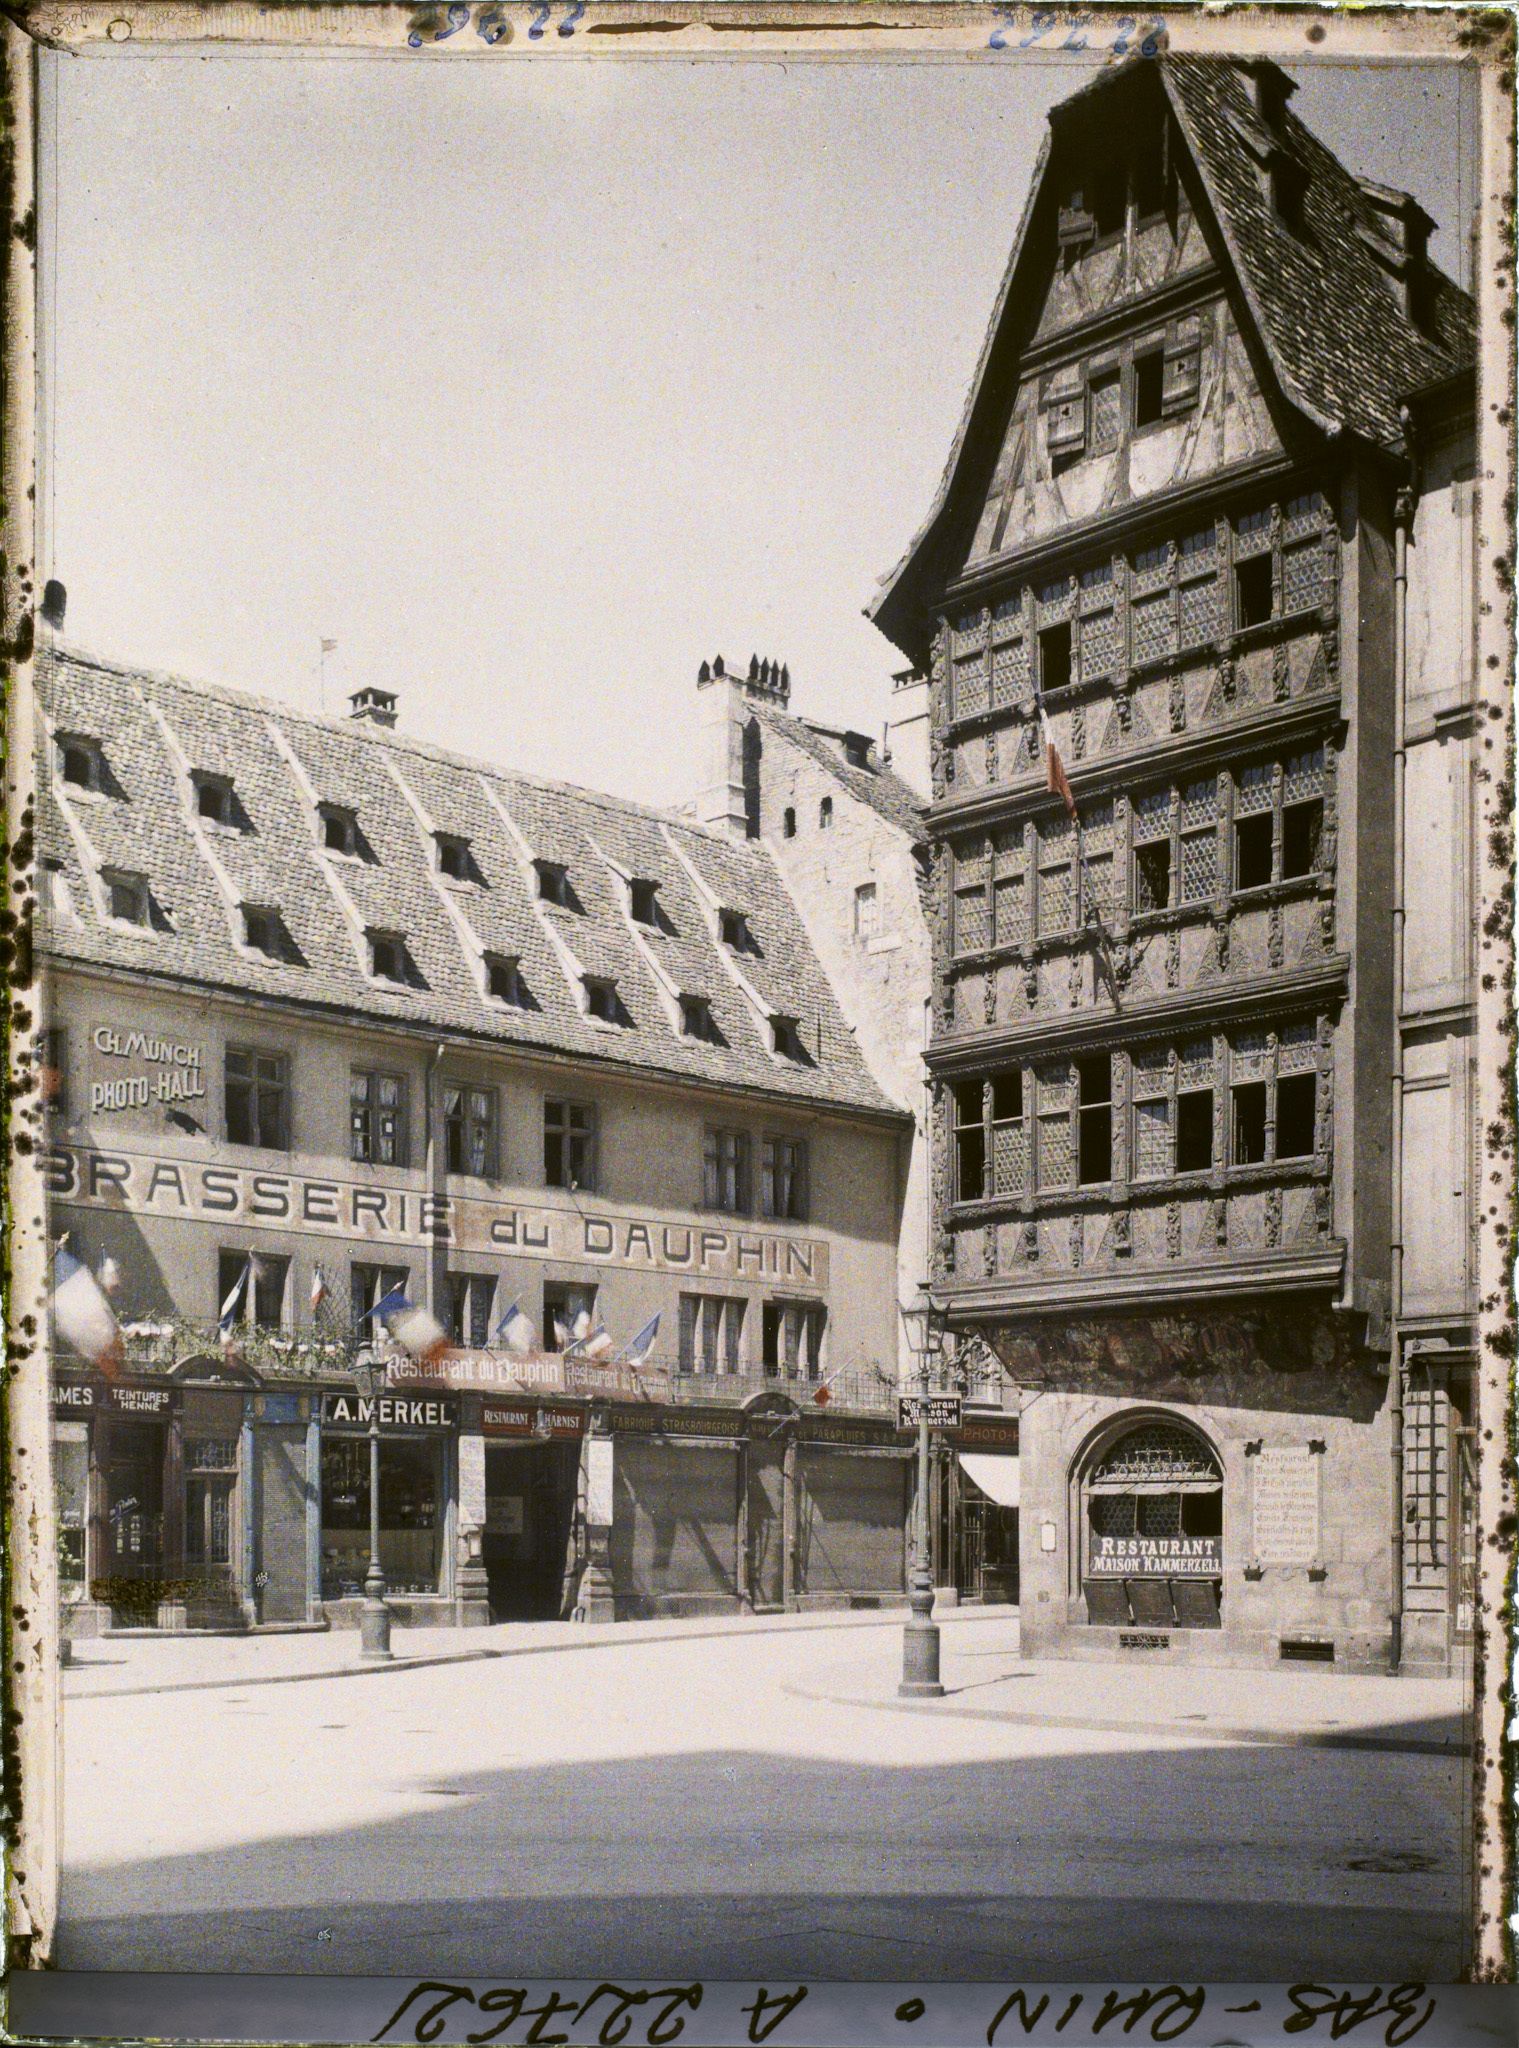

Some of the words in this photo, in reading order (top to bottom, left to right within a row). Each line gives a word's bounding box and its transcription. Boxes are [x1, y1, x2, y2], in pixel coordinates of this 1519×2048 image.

[122, 1032, 201, 1069] MUNCH
[91, 1069, 205, 1115] PHOTO-HALL
[45, 1150, 456, 1241] BRASSERIE
[490, 1211, 550, 1249] du
[584, 1218, 816, 1279] DAUPHIN
[386, 1353, 477, 1380] Restaurant
[478, 1355, 494, 1381] du
[496, 1357, 559, 1388] Dauphin
[112, 1388, 169, 1404] TEINTURES
[484, 1409, 528, 1425] RESTAURANT
[544, 1413, 580, 1429] HARNIST
[662, 1418, 740, 1435] STRASBOURGEOISE
[1101, 1537, 1214, 1555] RESTAURANT
[1092, 1556, 1140, 1572] MAISON
[1143, 1555, 1222, 1573] KAMMERZELL
